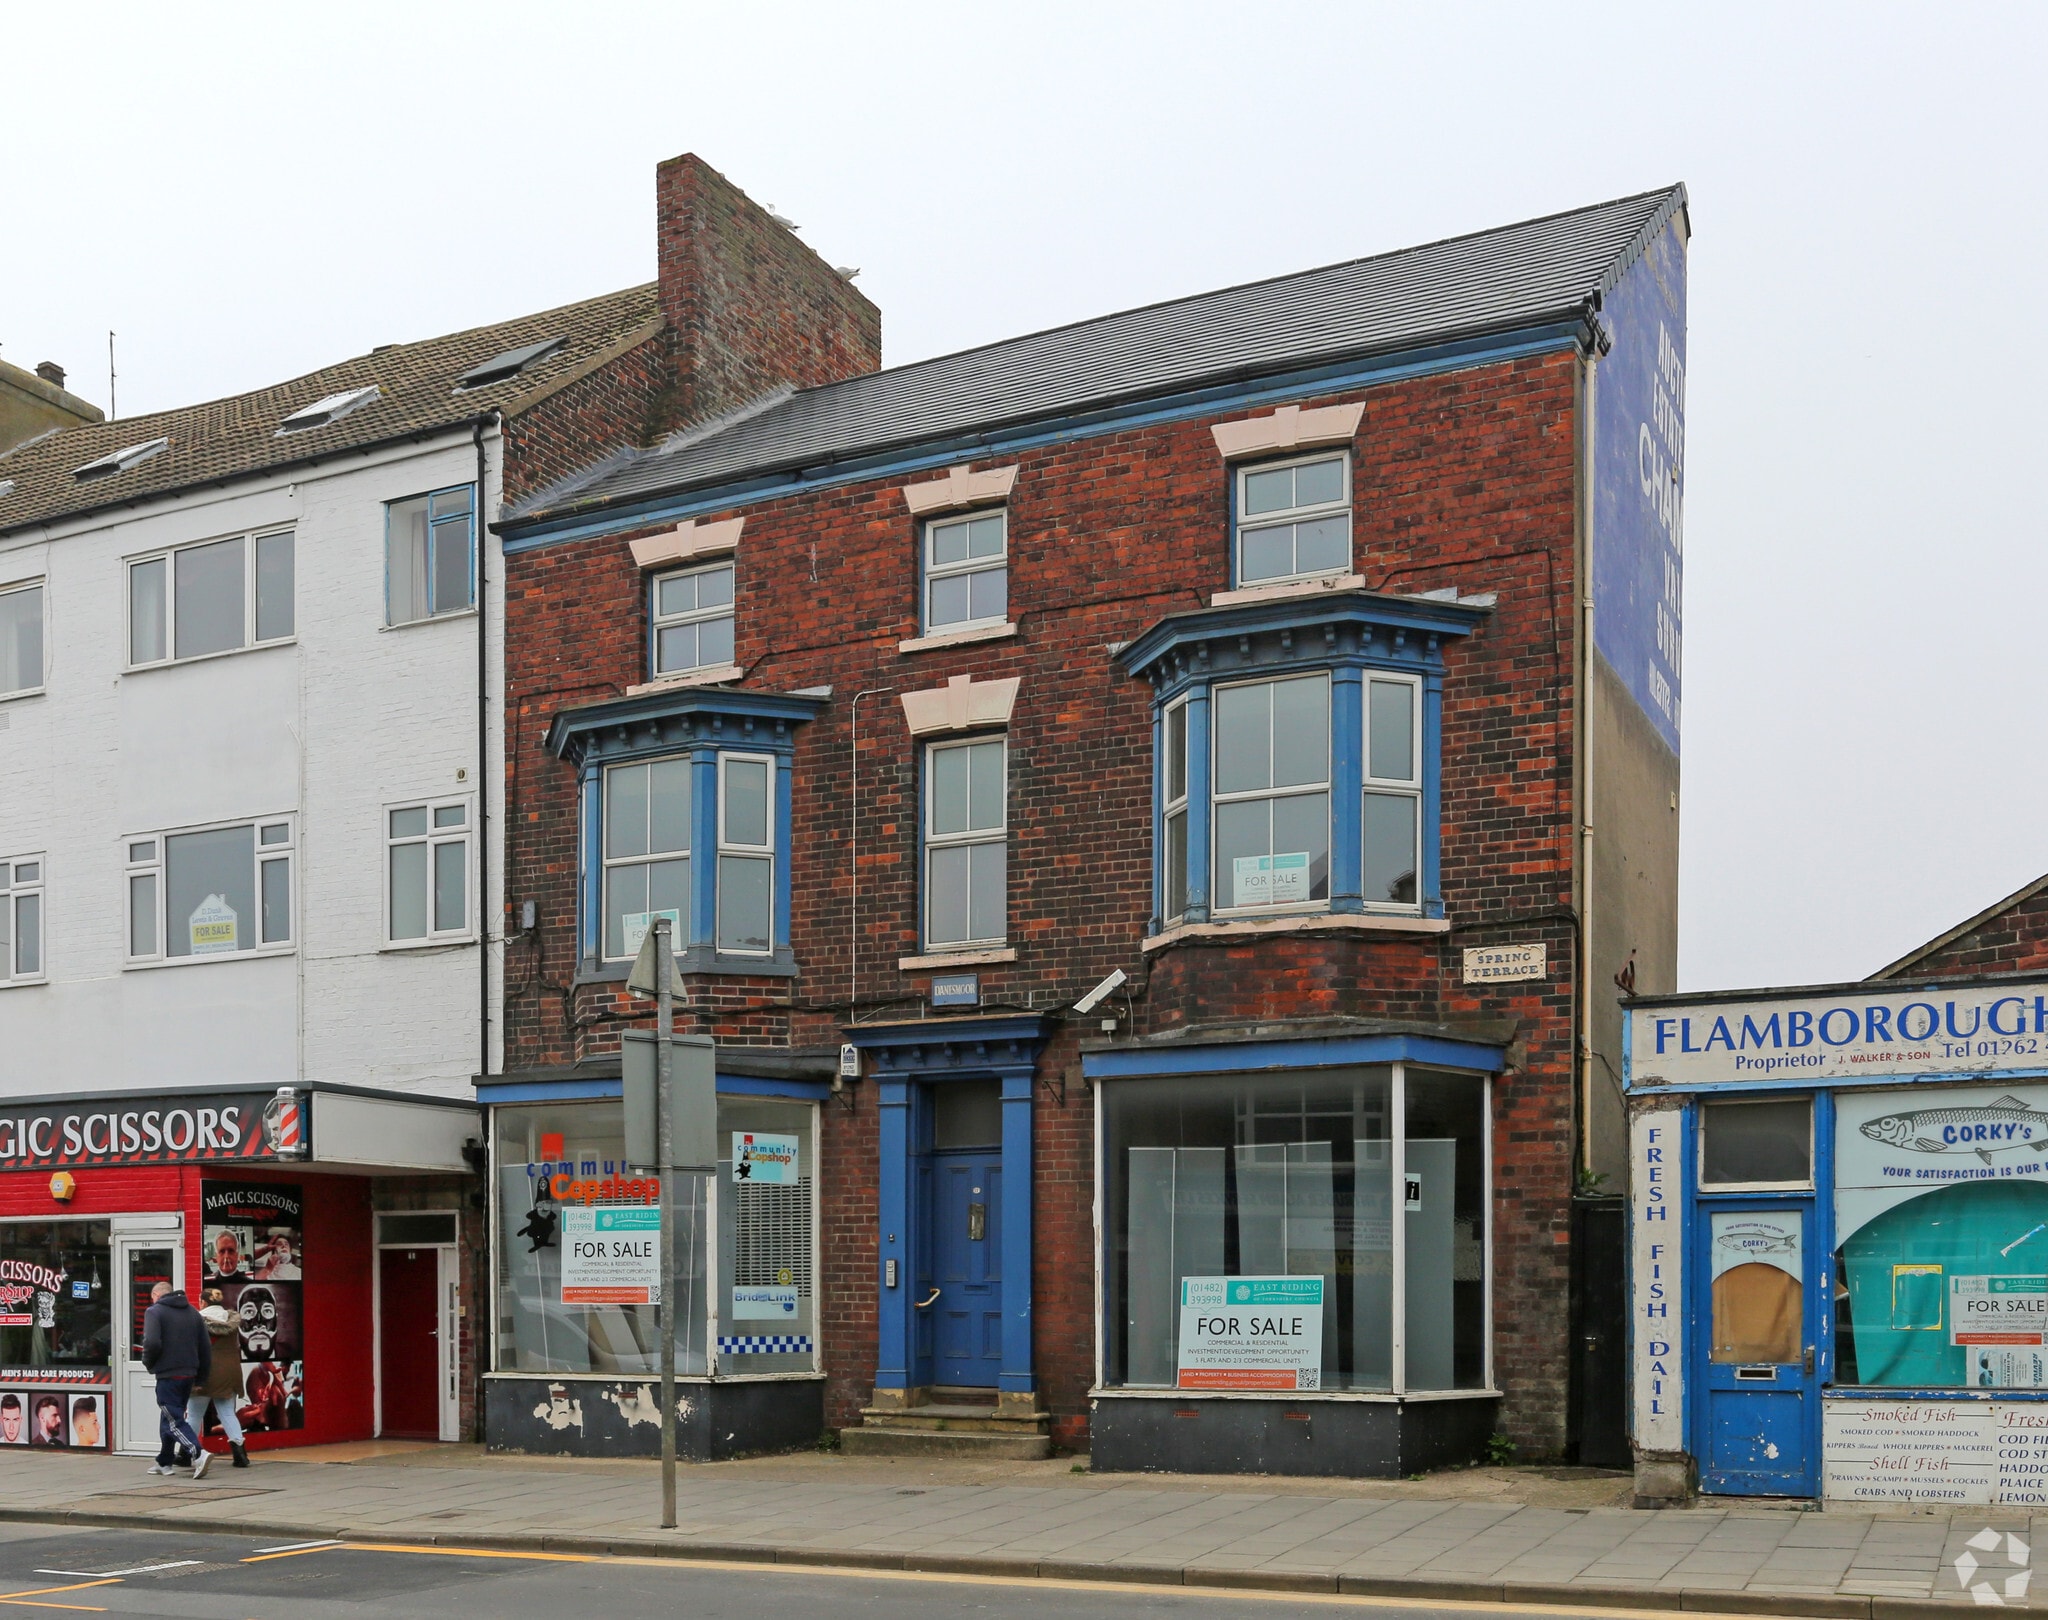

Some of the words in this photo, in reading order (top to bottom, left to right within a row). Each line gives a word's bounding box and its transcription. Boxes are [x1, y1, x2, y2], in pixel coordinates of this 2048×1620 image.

[1653, 371, 1683, 472] ESTATE
[1245, 876, 1267, 886] FOR
[195, 927, 210, 936] FOR
[211, 925, 231, 935] SALE
[1477, 952, 1531, 964] SPRING
[1471, 965, 1539, 977] TERRACE
[1735, 1052, 1826, 1073] Proprietor
[1850, 1052, 1892, 1063] WALKER
[1896, 1053, 1903, 1061] &
[1908, 1052, 1931, 1060] SON
[1942, 1041, 1970, 1058] Tel
[63, 1106, 241, 1156] SCISSORS
[737, 1144, 797, 1156] community
[747, 1150, 791, 1165] Copshop
[1646, 1128, 1666, 1221] FRESH
[1882, 1166, 1911, 1178] YOUR
[1916, 1168, 1995, 1179] SATISFACTION
[2000, 1167, 2012, 1176] IS
[2017, 1163, 2041, 1175] OUR
[550, 1172, 660, 1207] Copshop
[205, 1191, 245, 1210] MAGIC
[246, 1191, 300, 1214] SCISSORS
[574, 1242, 607, 1258] FOR
[613, 1242, 652, 1258] SALE
[1281, 1283, 1320, 1291] RIDING
[1647, 1245, 1667, 1318] FISH
[1191, 1283, 1223, 1293] (01482)
[1191, 1295, 1223, 1304] 393998
[1967, 1300, 2000, 1312] FOR
[2007, 1300, 2045, 1312] SALE
[1197, 1317, 1241, 1335] FOR
[1250, 1317, 1303, 1335] SALE
[1, 1369, 21, 1377] MEN'S
[22, 1369, 39, 1378] HAIR
[40, 1370, 57, 1378] CARE
[59, 1370, 94, 1379] PRODUCTS
[1649, 1341, 1670, 1422] DAIL
[1862, 1407, 1922, 1424] Smoked
[1923, 1407, 1956, 1423] Fish
[2004, 1411, 2048, 1429] Fres
[1998, 1434, 2029, 1445] COD
[1953, 1444, 1993, 1452] MACKEREL
[1998, 1448, 2029, 1459] COD
[1869, 1455, 1911, 1471] Shell
[1914, 1456, 1950, 1472] Fish
[1952, 1477, 1989, 1485] COCKLES
[1999, 1478, 2044, 1488] PLAICE
[1854, 1487, 1886, 1496] CRABS
[1890, 1488, 1912, 1497] AND
[1916, 1489, 1966, 1498] LOBSTERS
[1999, 1492, 2047, 1503] LEMON
